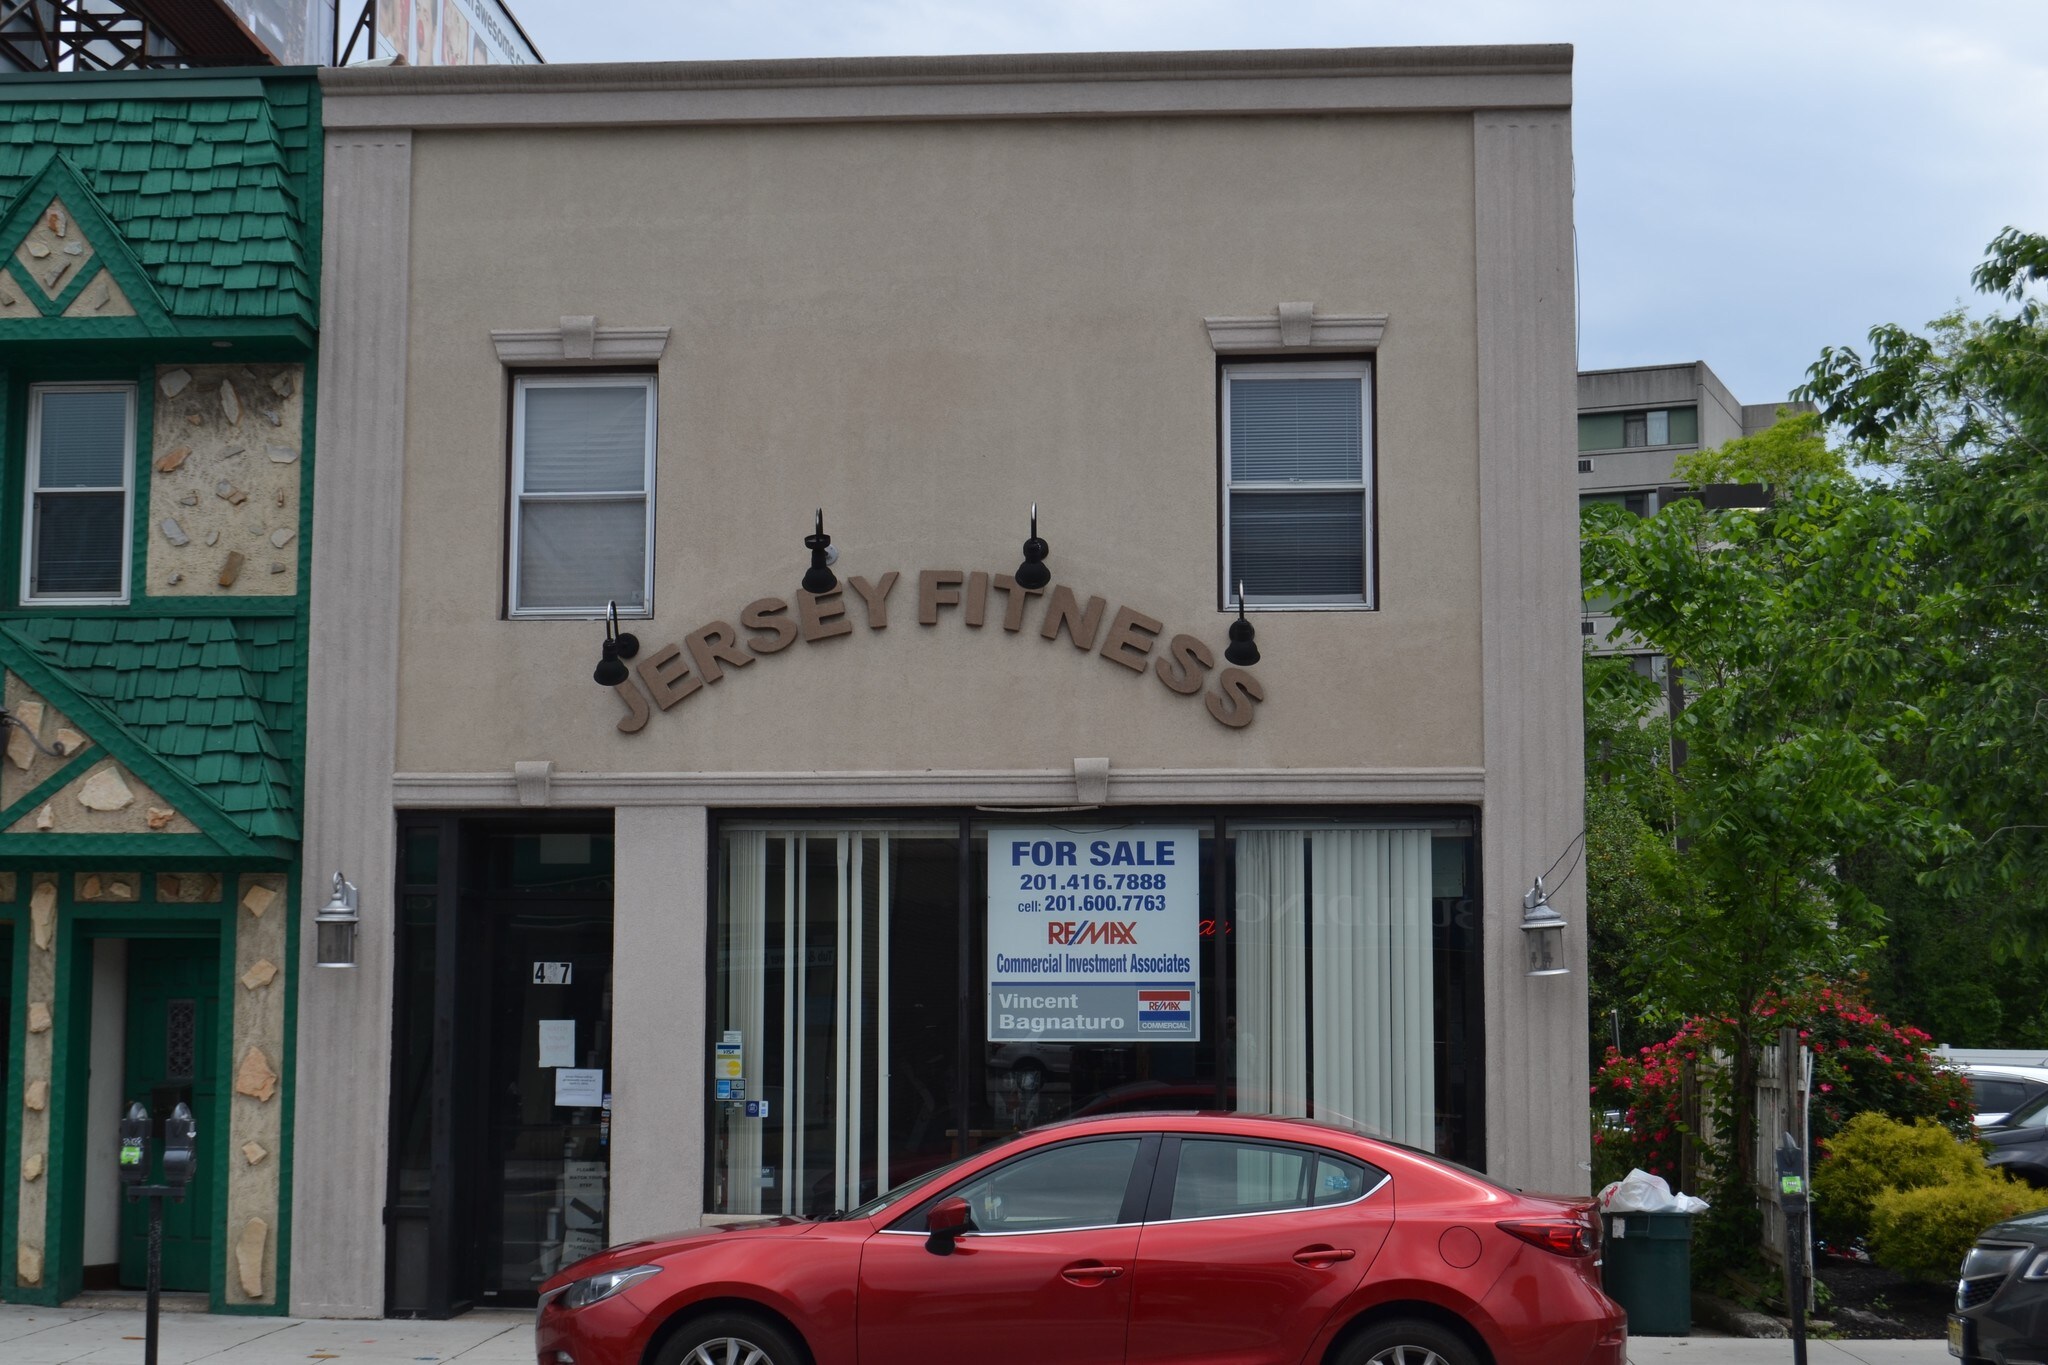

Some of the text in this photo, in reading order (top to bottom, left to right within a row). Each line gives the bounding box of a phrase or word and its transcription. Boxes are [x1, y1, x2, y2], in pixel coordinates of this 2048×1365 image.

[475, 2, 515, 64] awesome
[612, 569, 1265, 734] JERSEY FITNESS
[1011, 841, 1176, 866] FOR SALE
[1020, 874, 1167, 890] 201.416.7888
[1018, 895, 1167, 913] cell: 201.600.7763
[1048, 920, 1138, 945] RE/MAX
[996, 953, 1190, 973] Commercial Investment Associates
[998, 993, 1079, 1009] Vincent
[1148, 1000, 1181, 1011] RE/MAX
[999, 1014, 1125, 1033] Bagnaturo
[1142, 1022, 1187, 1030] COMMERCIAL
